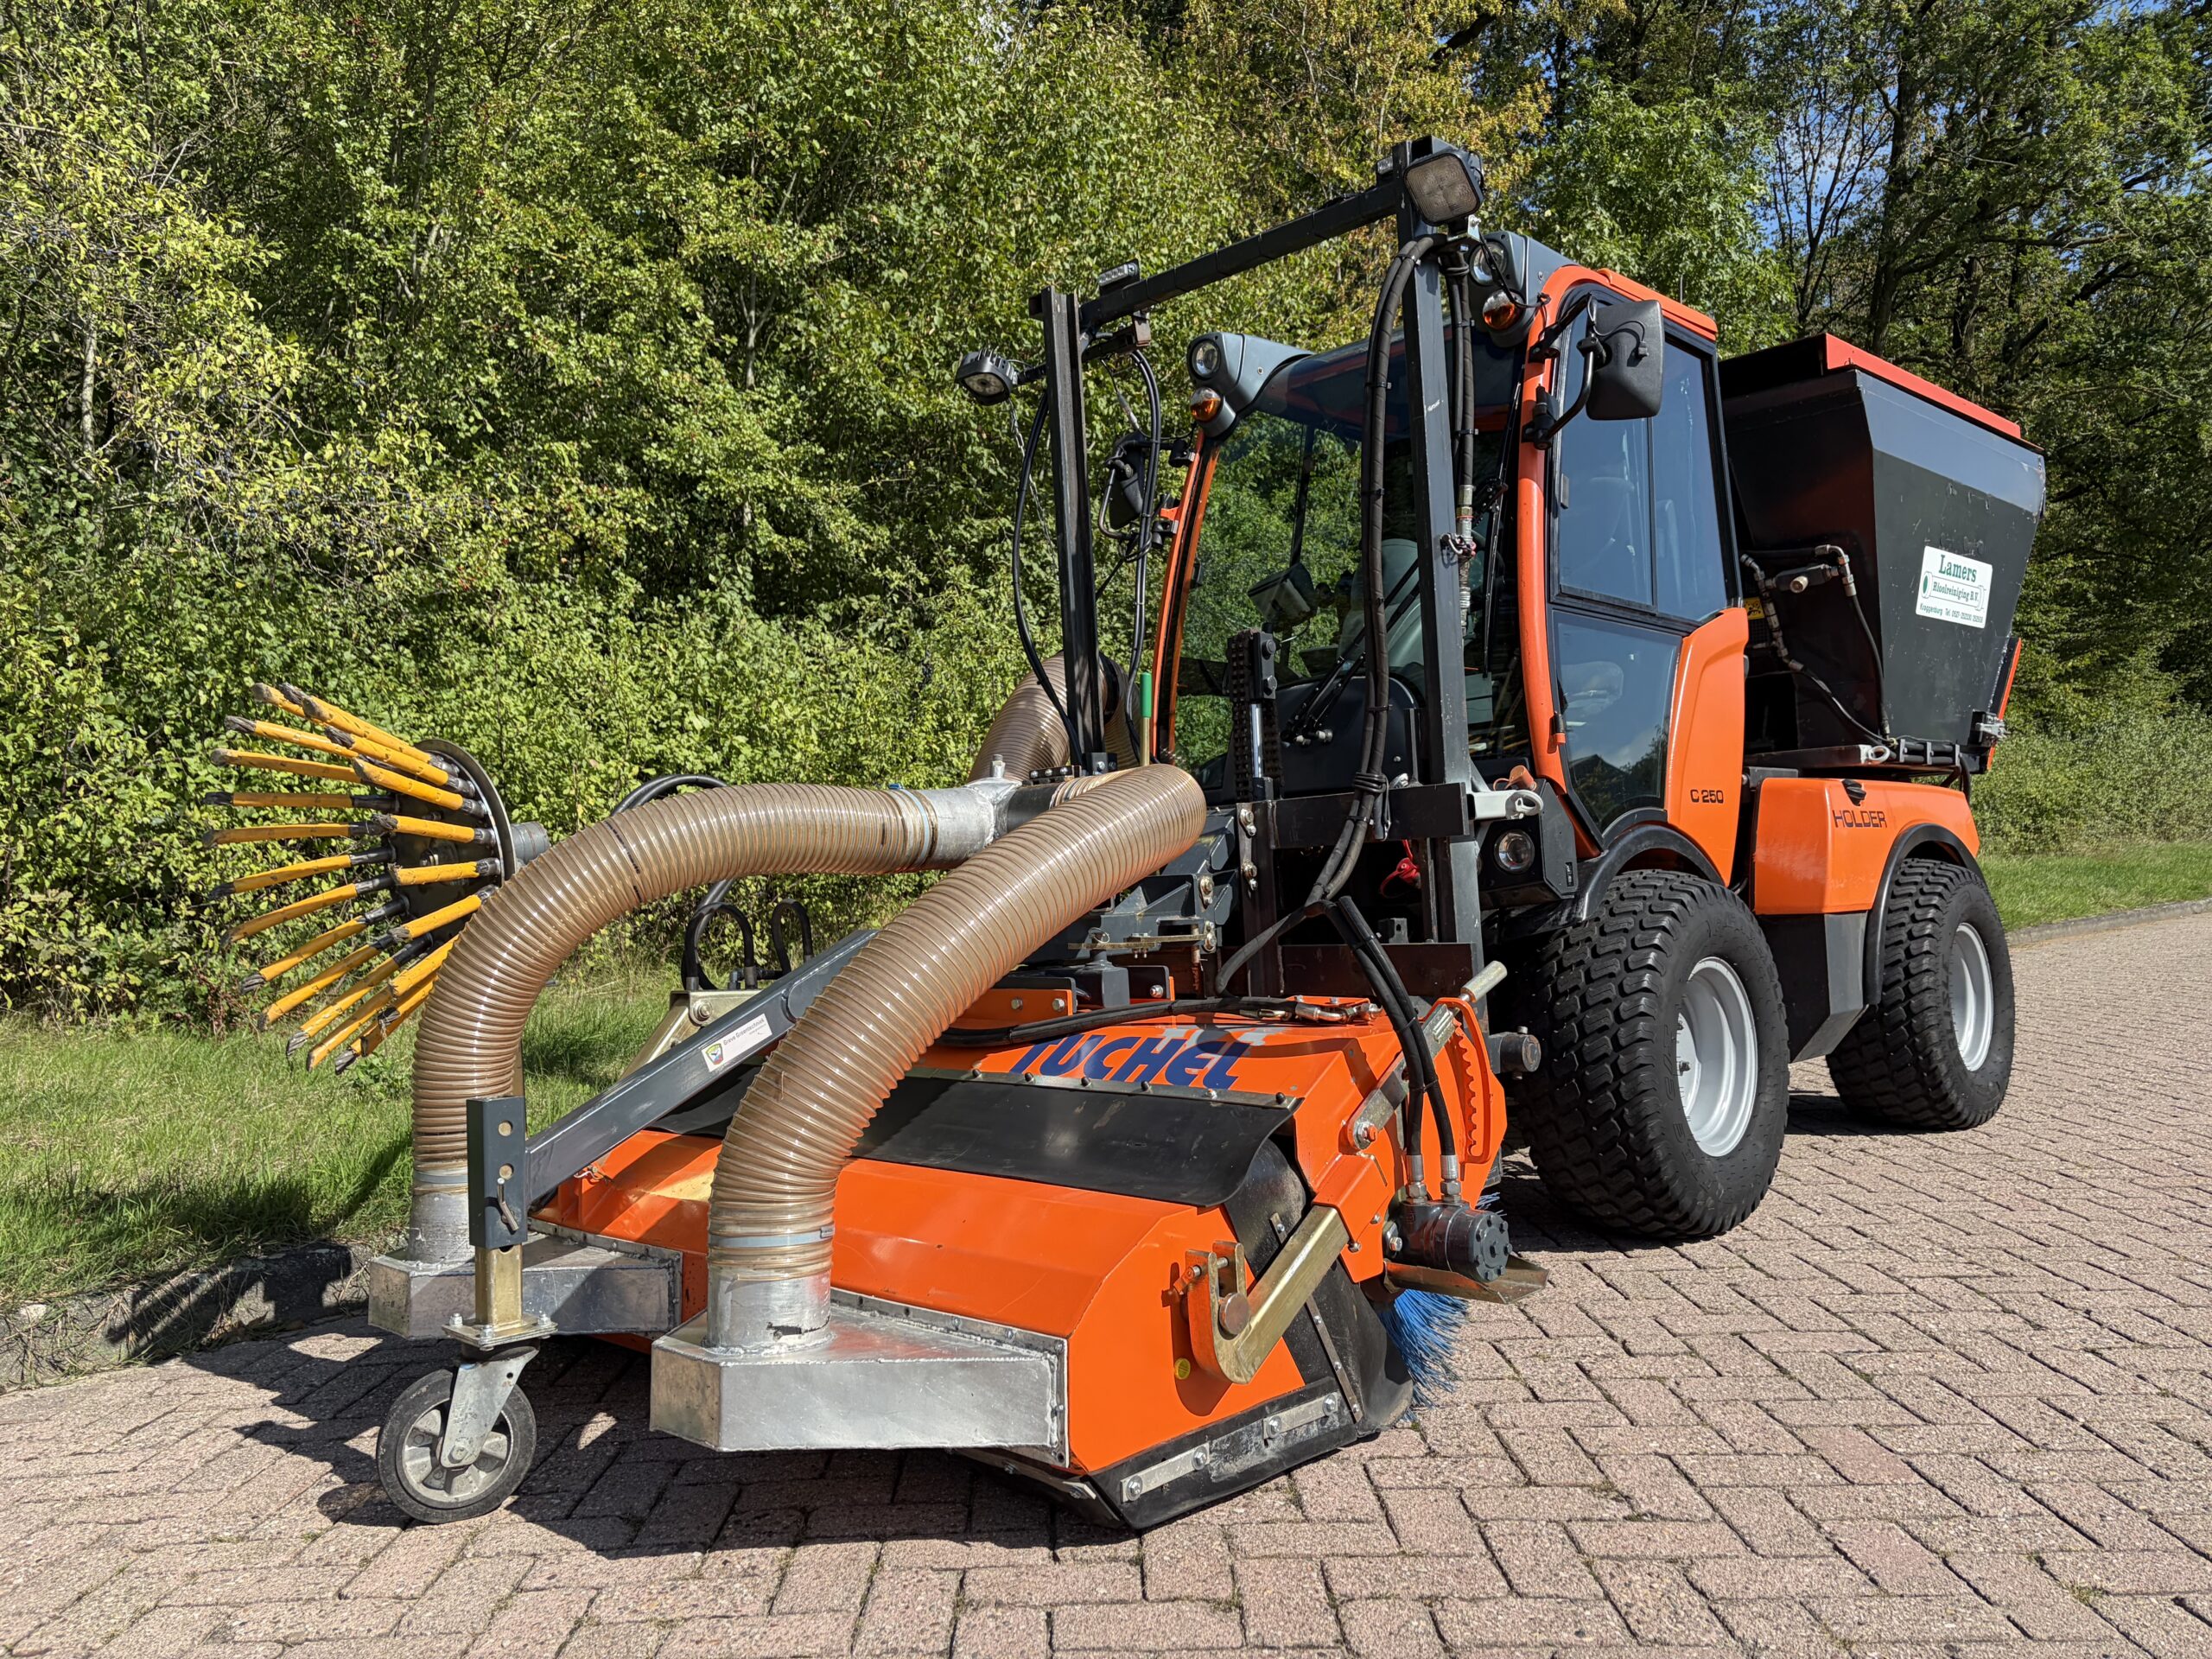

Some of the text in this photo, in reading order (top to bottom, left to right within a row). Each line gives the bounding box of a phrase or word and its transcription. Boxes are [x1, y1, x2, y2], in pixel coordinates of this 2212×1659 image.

[1938, 554, 1977, 583] Lamers
[1690, 789, 1724, 804] C 250
[1832, 810, 1888, 829] HOLDER
[1008, 1033, 1251, 1090] TUCHEL
